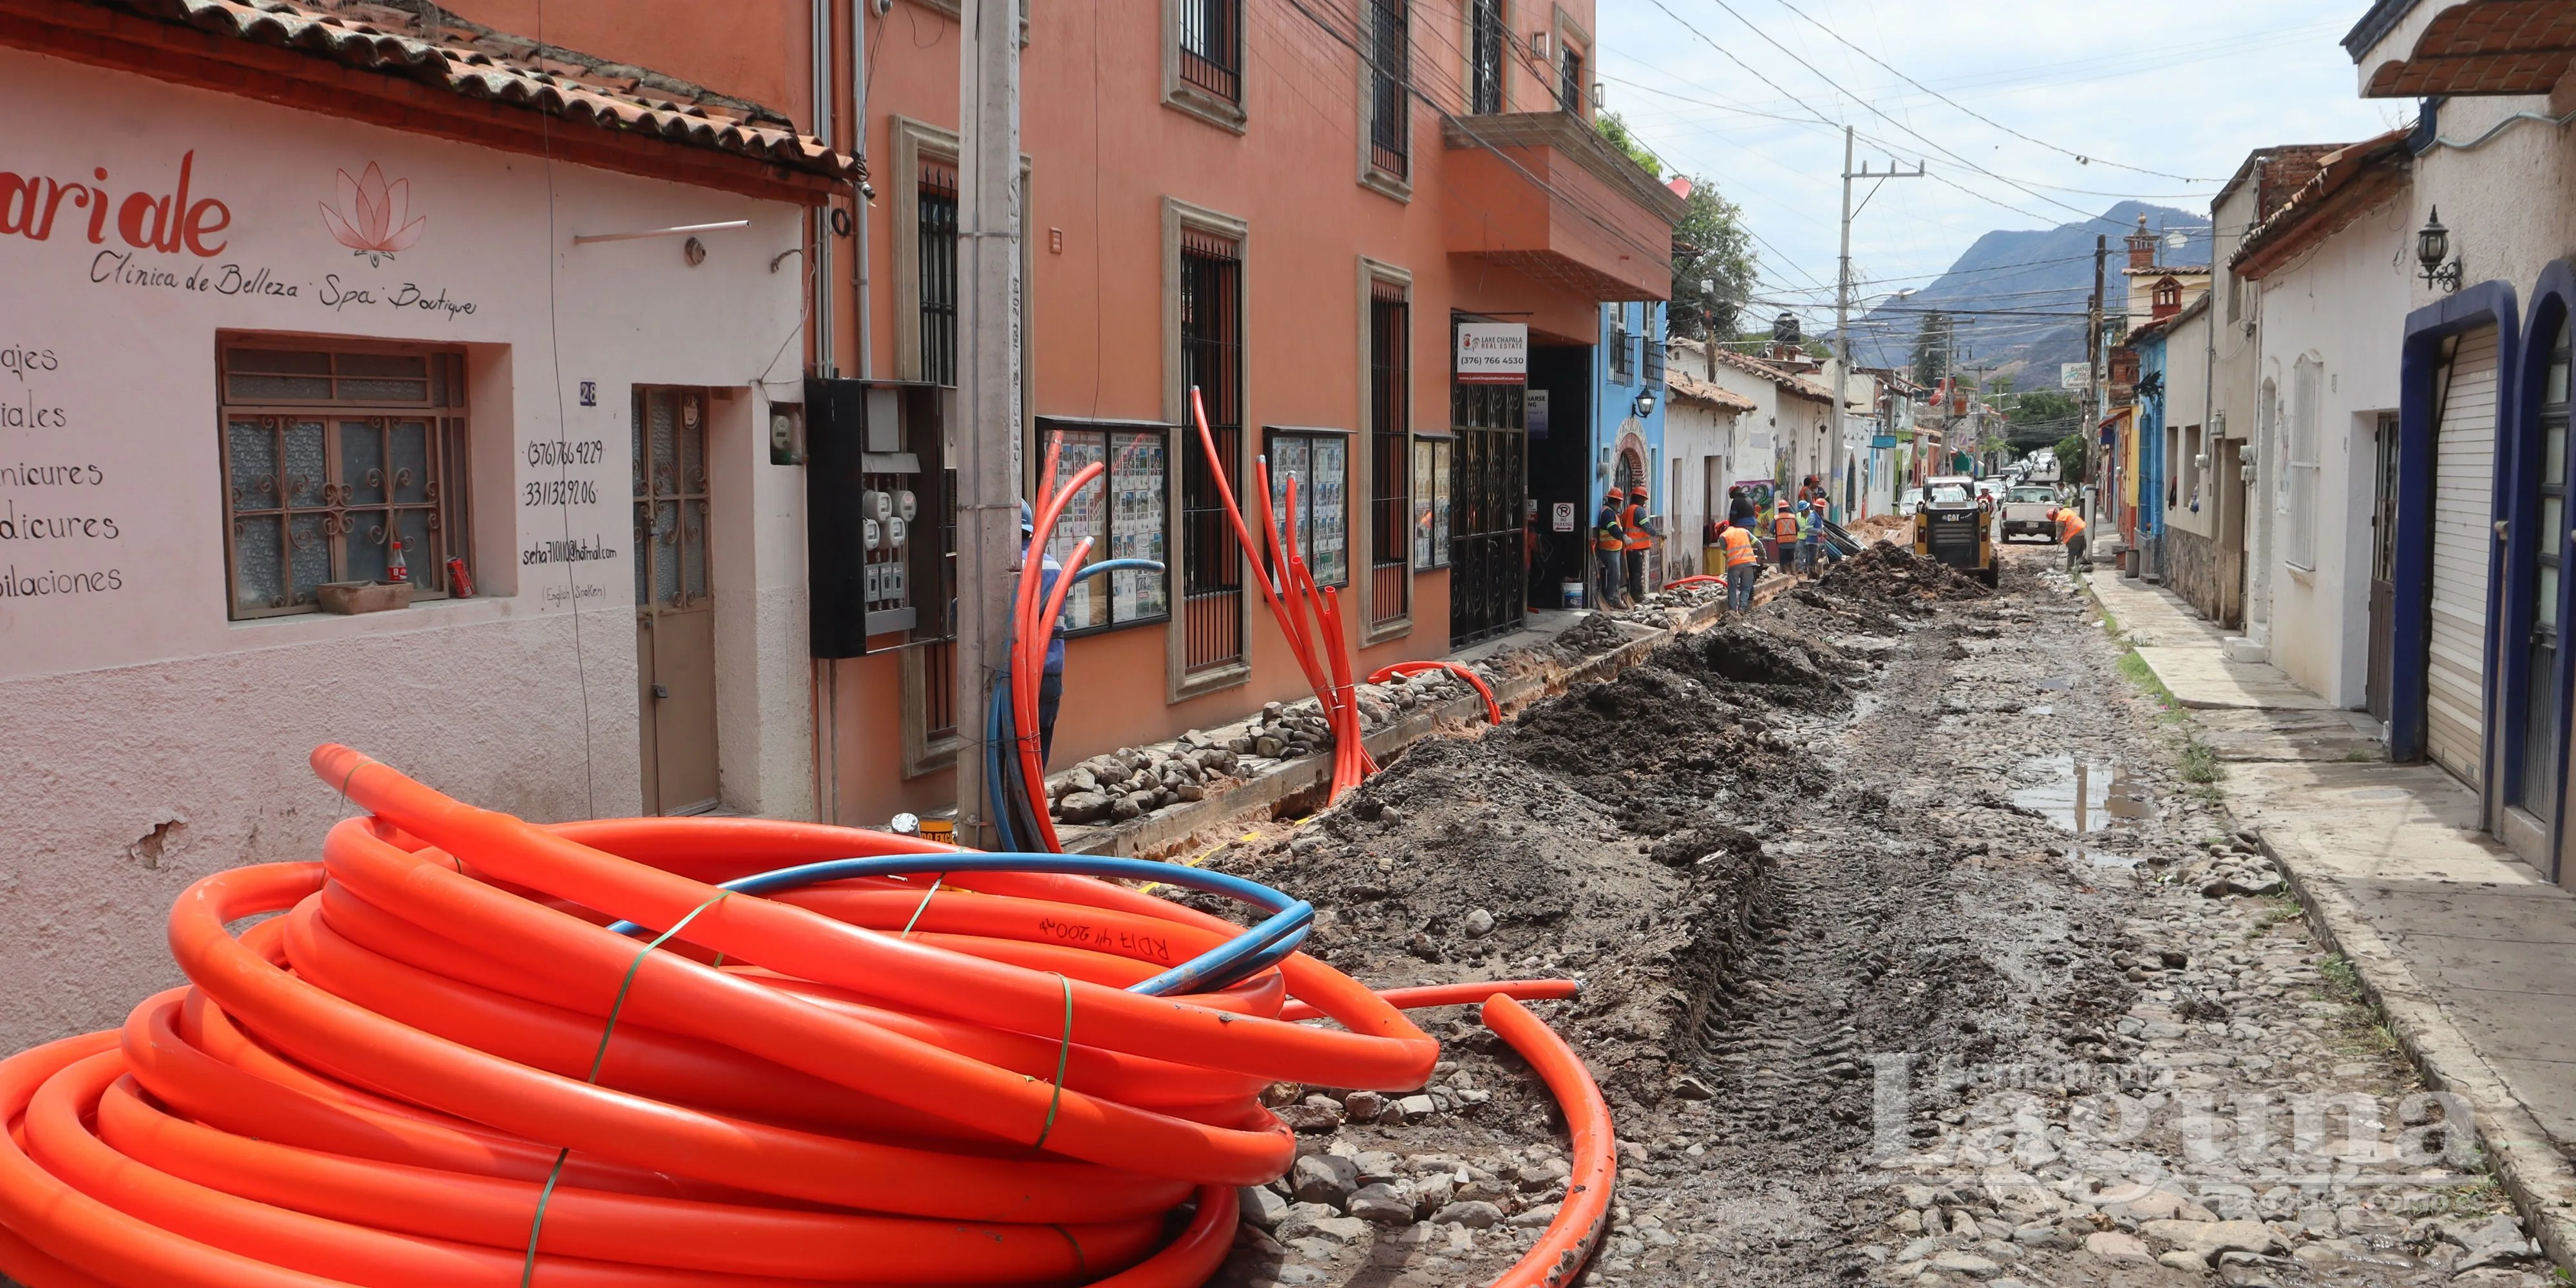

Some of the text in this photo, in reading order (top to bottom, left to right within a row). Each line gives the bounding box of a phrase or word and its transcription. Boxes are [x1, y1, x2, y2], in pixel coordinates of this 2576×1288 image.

[186, 265, 209, 292] de
[214, 265, 298, 297] Belleza
[319, 274, 377, 312] Spa
[388, 283, 477, 321] Boutique
[1461, 356, 1482, 366] (376)
[580, 383, 596, 404] 28
[0, 564, 122, 598] ilaciones
[1120, 932, 1170, 960] RD17
